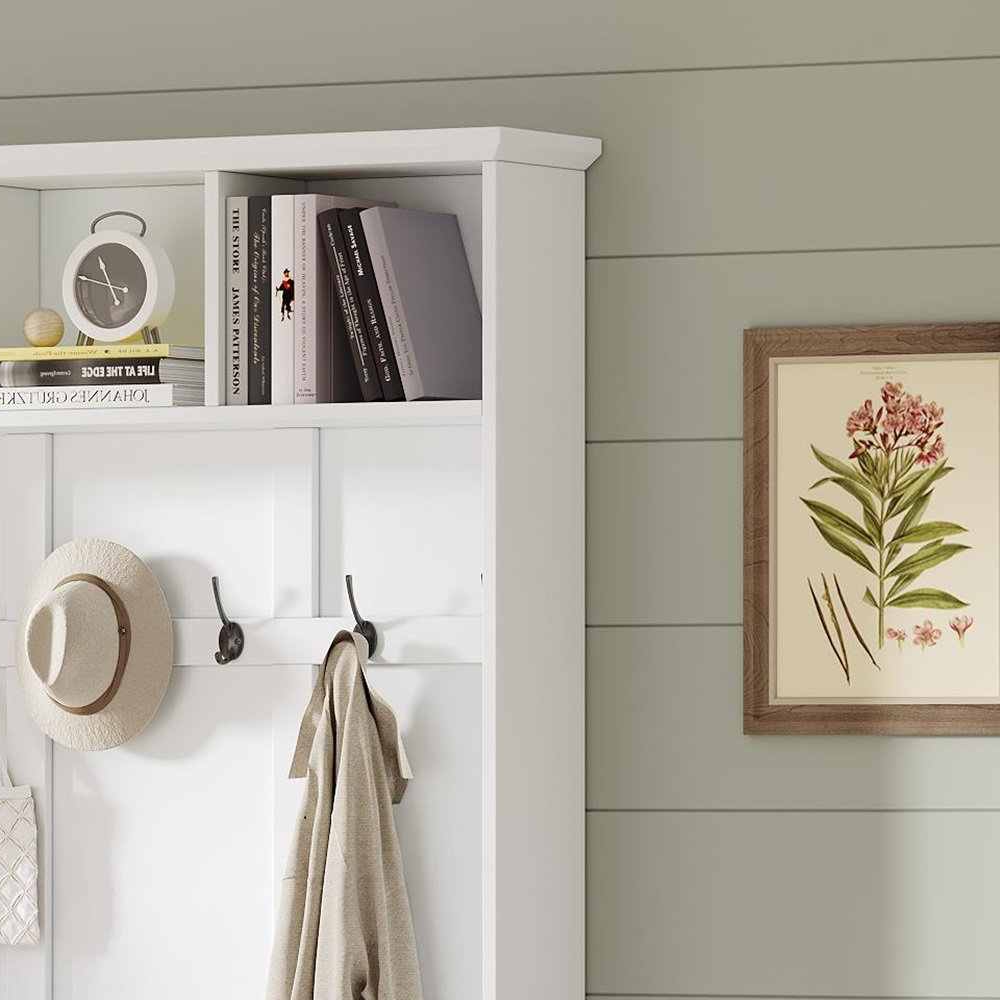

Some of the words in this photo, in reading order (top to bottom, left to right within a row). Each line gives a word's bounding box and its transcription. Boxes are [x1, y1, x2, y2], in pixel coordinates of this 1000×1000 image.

[232, 208, 240, 232] THE
[232, 236, 240, 274] STORE
[232, 287, 240, 324] JAMES
[232, 329, 240, 395] PATTERSON
